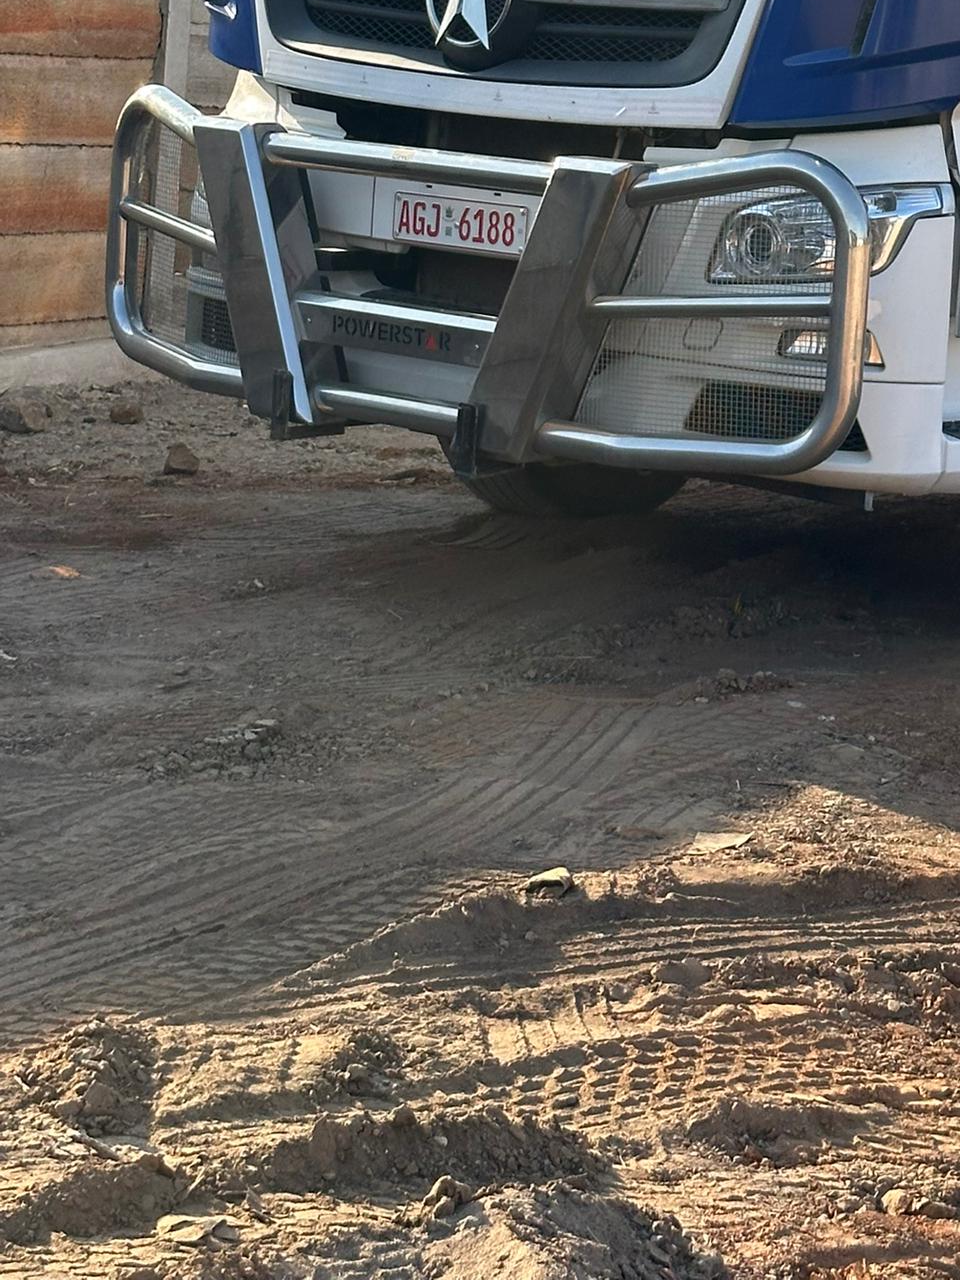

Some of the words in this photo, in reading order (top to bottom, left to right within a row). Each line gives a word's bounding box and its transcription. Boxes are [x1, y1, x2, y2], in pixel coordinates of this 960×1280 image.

[398, 200, 441, 237] AGJ
[459, 207, 515, 247] 6188
[333, 315, 450, 352] POWERSTAR
